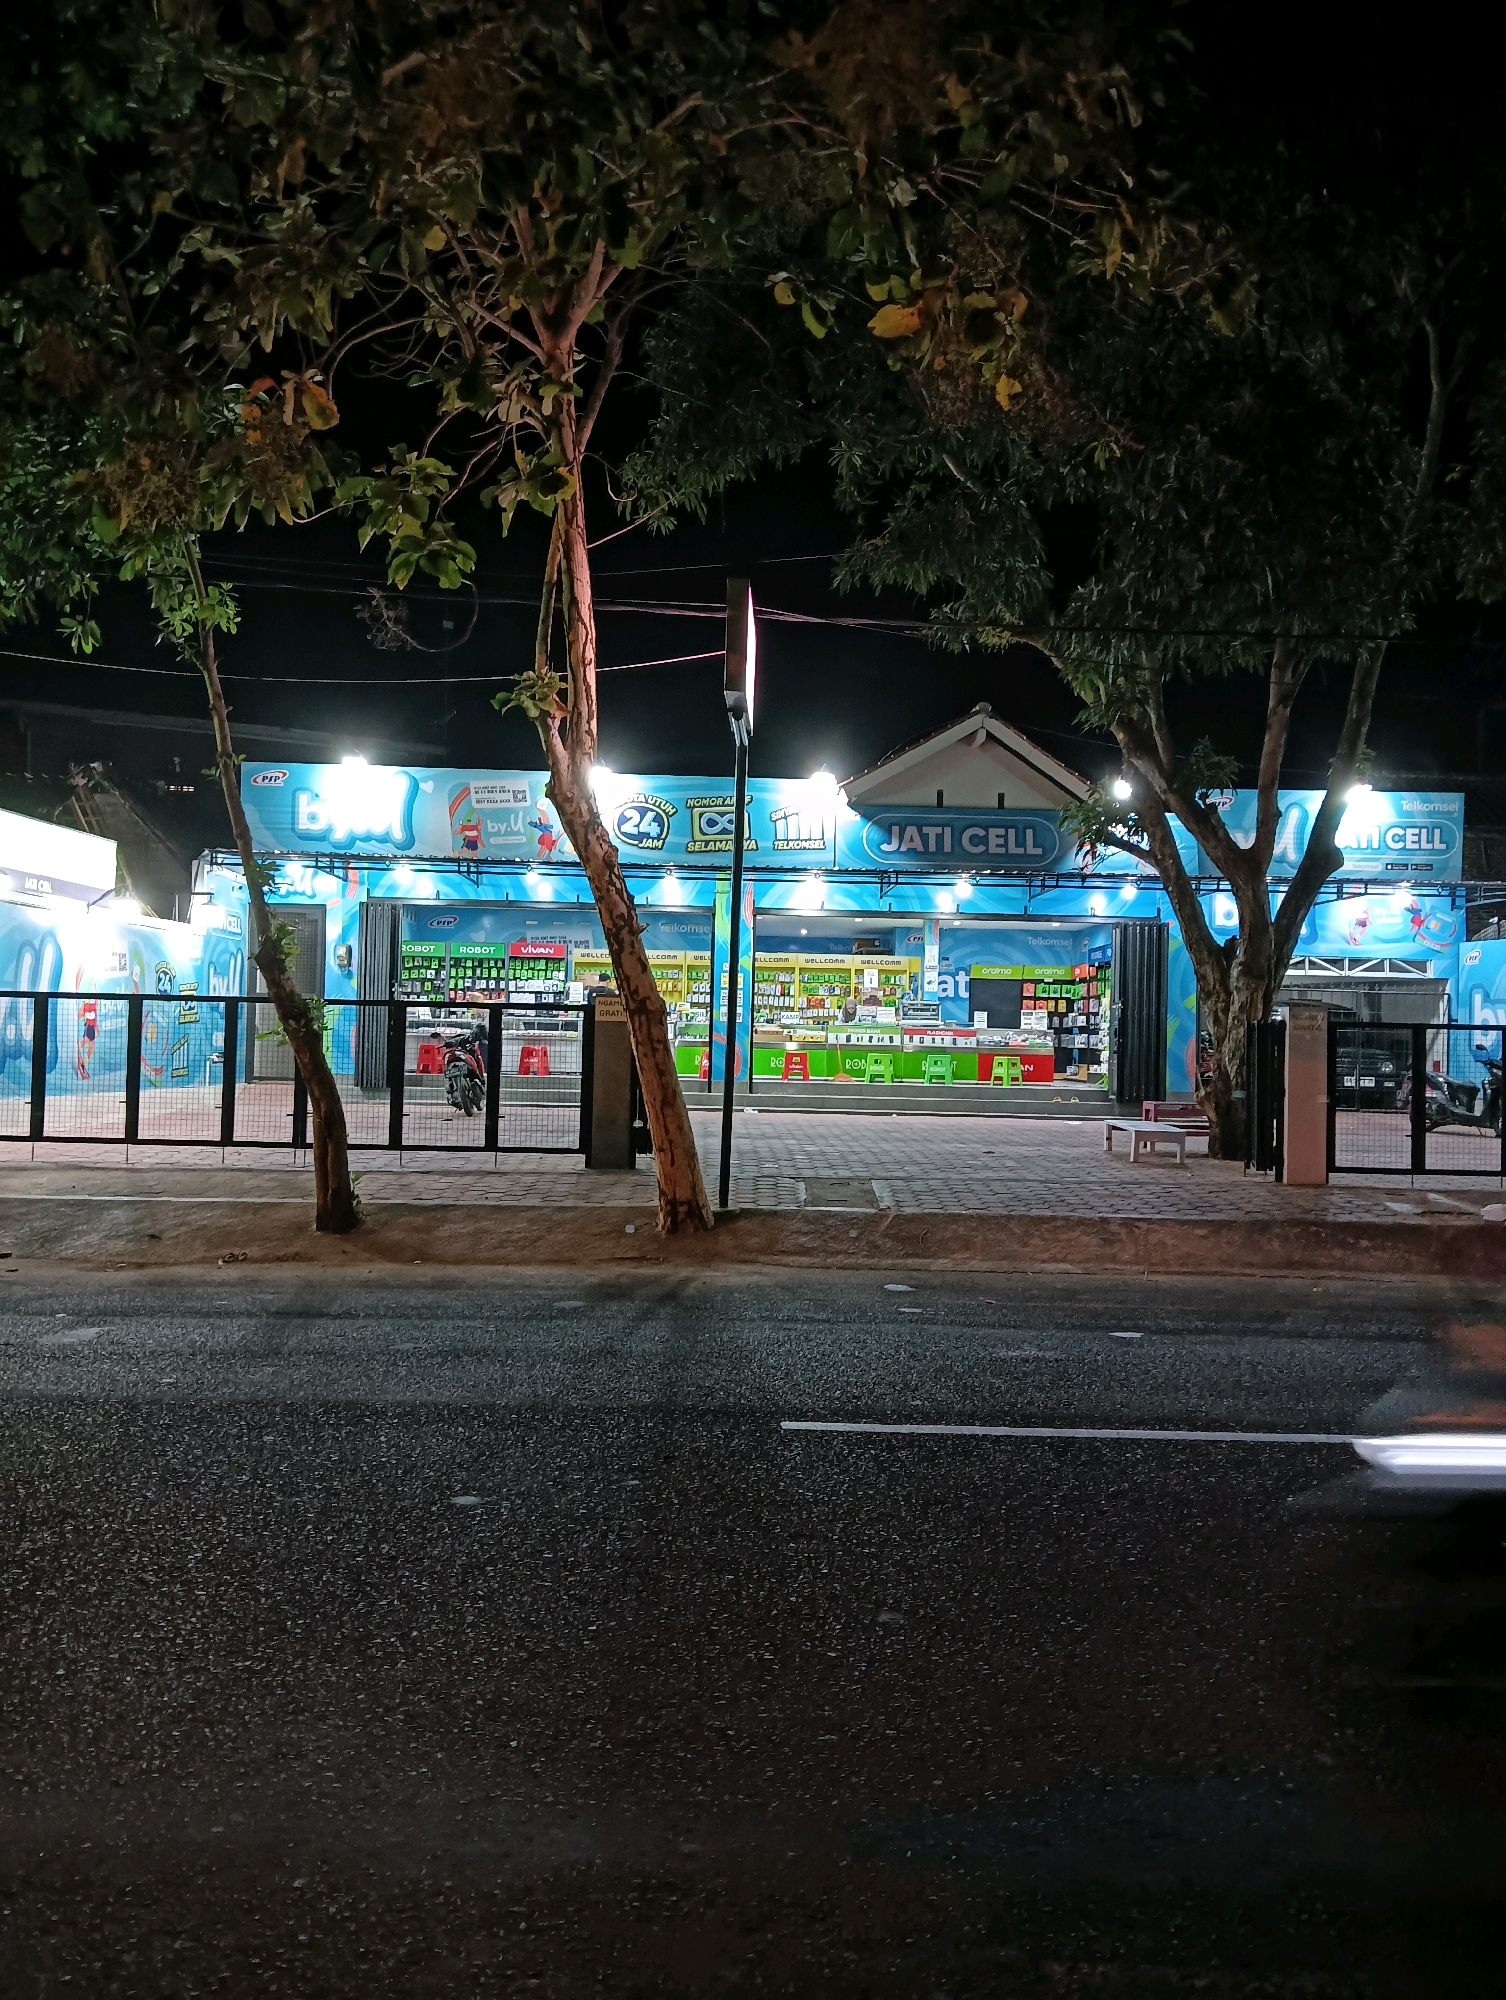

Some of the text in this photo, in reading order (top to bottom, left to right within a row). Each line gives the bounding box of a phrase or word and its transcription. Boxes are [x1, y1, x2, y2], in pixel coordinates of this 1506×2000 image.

[262, 774, 281, 783] PSP
[648, 795, 677, 815] UTUH
[687, 797, 720, 807] NOMOR
[1401, 800, 1459, 812] Telkomsel
[487, 811, 525, 835] by.U
[620, 807, 661, 836] 24
[638, 838, 664, 849] JAM
[880, 826, 1043, 855] JATI CELL
[1385, 828, 1447, 850] CELL
[687, 840, 757, 851] SELAMAYA
[774, 841, 826, 850] TELKOMSEL
[659, 922, 710, 933] Telkomse
[1028, 937, 1072, 946] Telkomsel
[459, 946, 496, 954] ROBOT
[981, 967, 1013, 975] oraimo
[1034, 967, 1066, 976] oraimo
[845, 1059, 866, 1070] ROB
